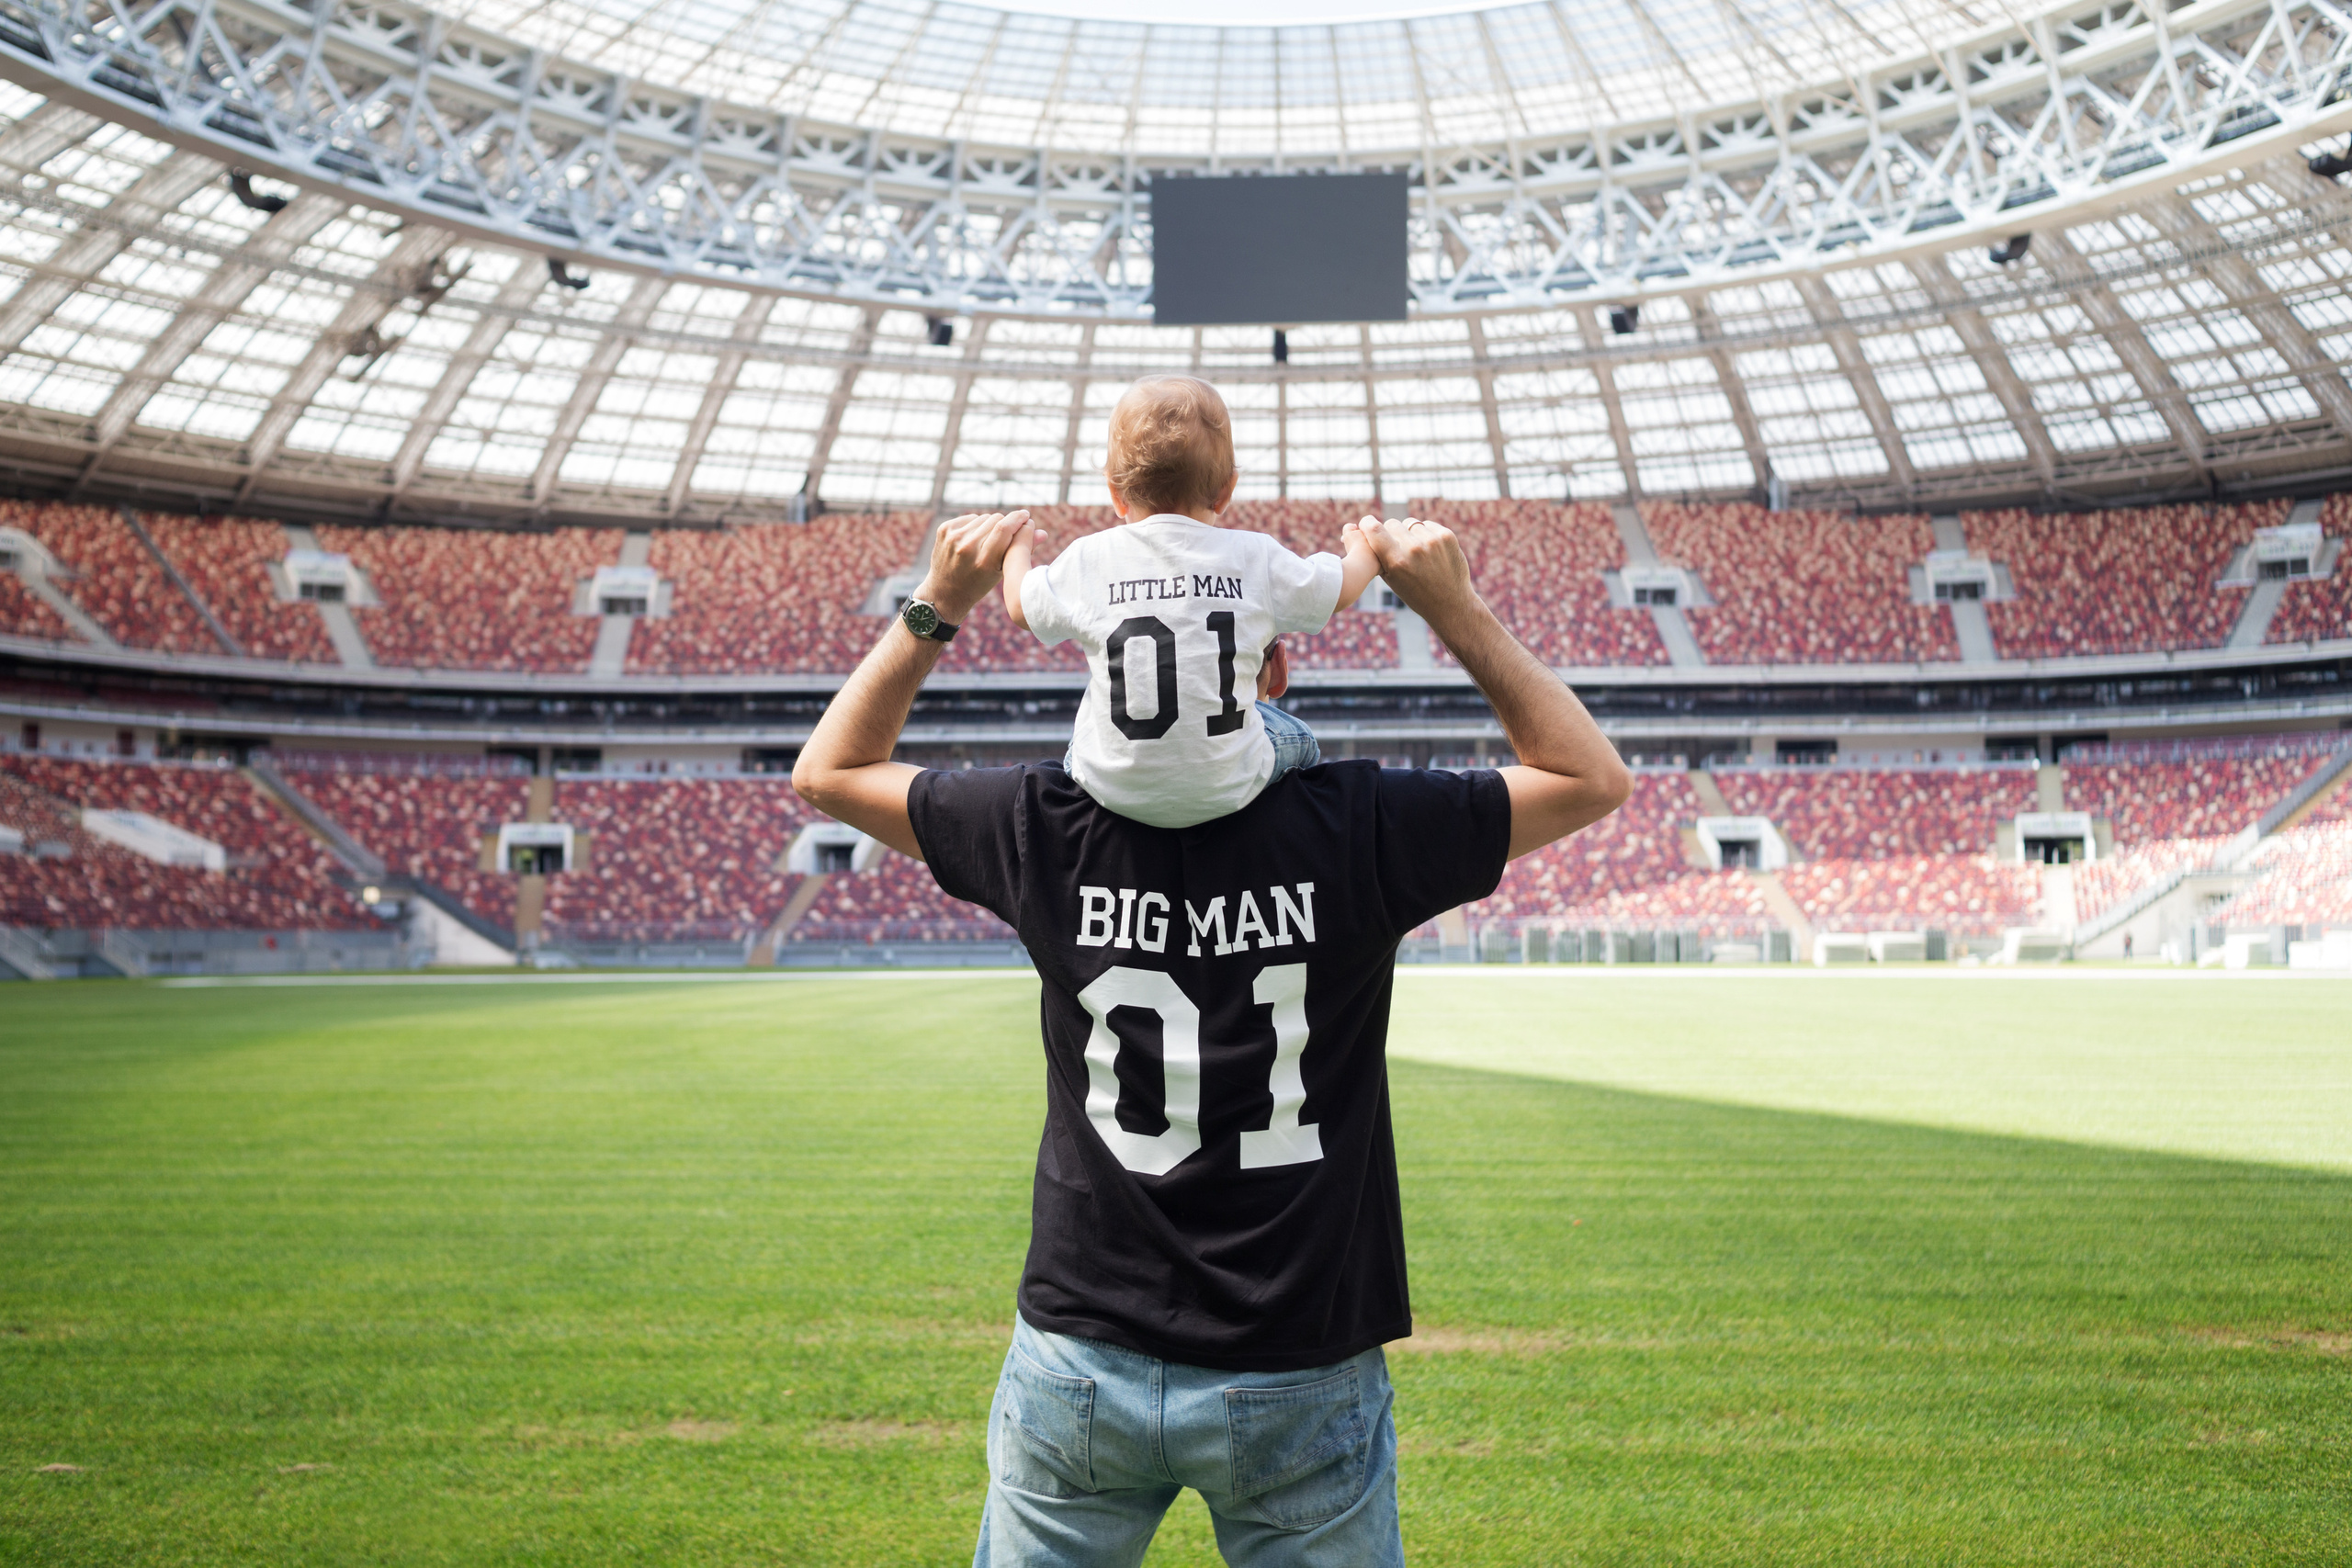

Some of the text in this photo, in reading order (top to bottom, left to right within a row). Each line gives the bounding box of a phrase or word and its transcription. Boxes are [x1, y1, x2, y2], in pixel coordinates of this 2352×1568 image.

[1108, 574, 1243, 605] LITTLE MAN
[1106, 611, 1246, 740] 01
[1076, 882, 1316, 957] BIG MAN
[1077, 962, 1324, 1177] 01
